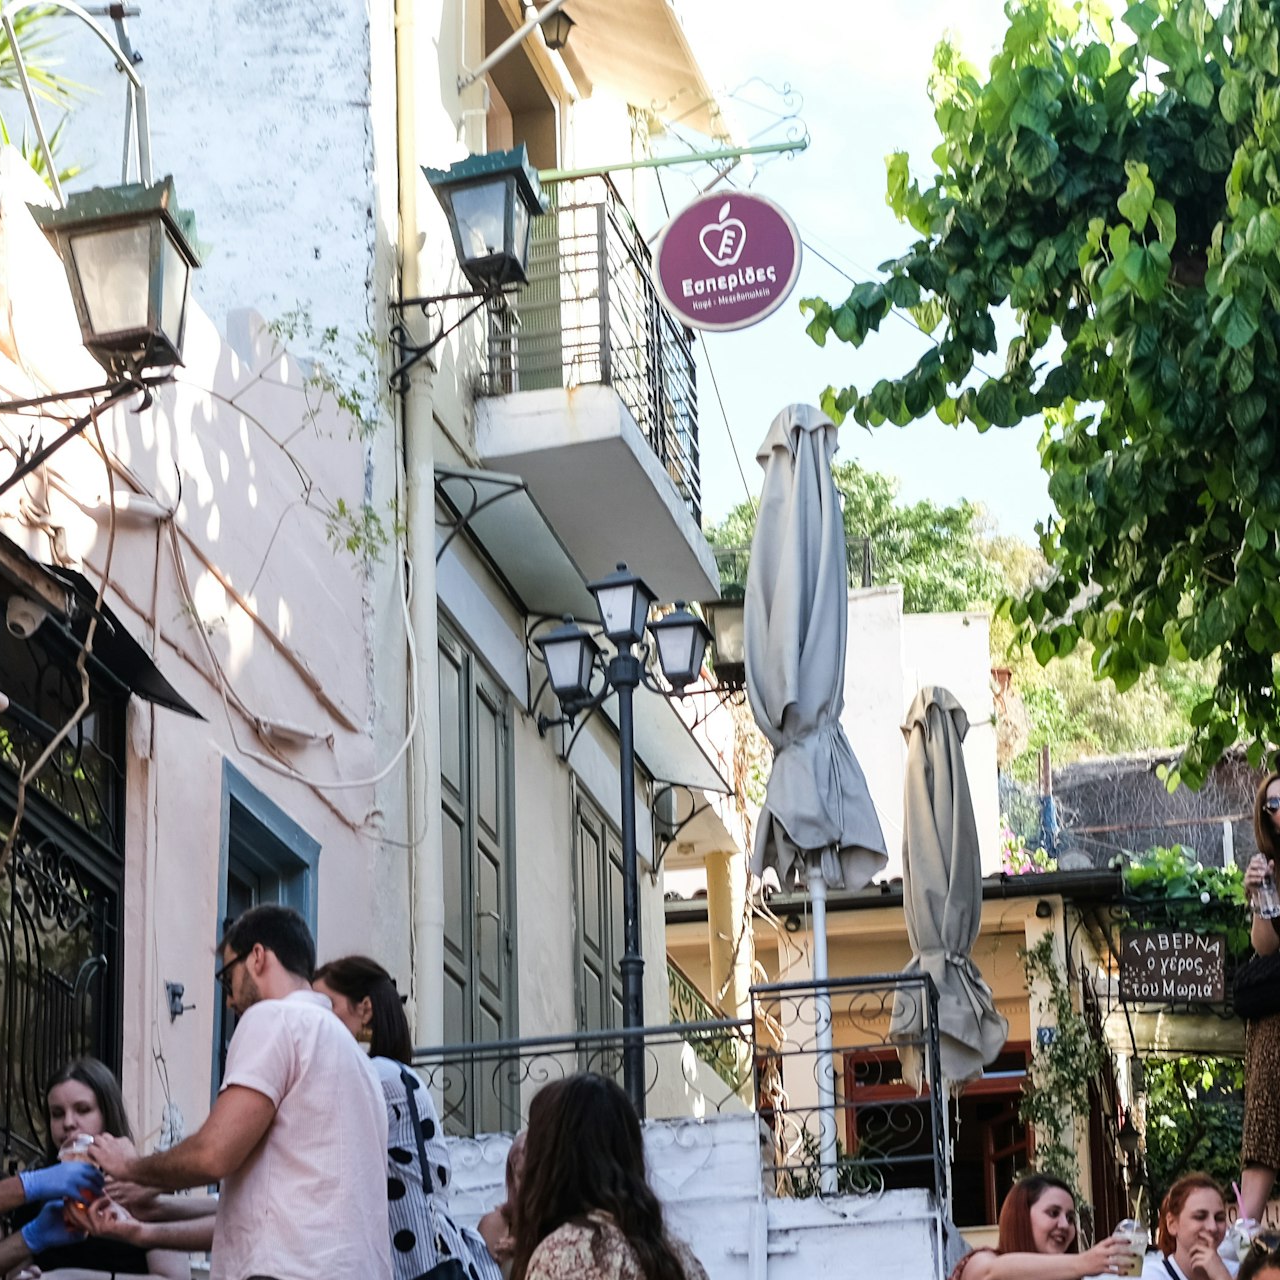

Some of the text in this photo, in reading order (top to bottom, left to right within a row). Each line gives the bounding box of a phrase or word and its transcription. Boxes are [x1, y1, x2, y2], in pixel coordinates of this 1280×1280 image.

[681, 265, 777, 298] Εσπερίδες
[1129, 932, 1220, 957] ΤΑΒΕΡΝΑ
[1160, 950, 1204, 976] γέρος
[1132, 983, 1159, 998] του
